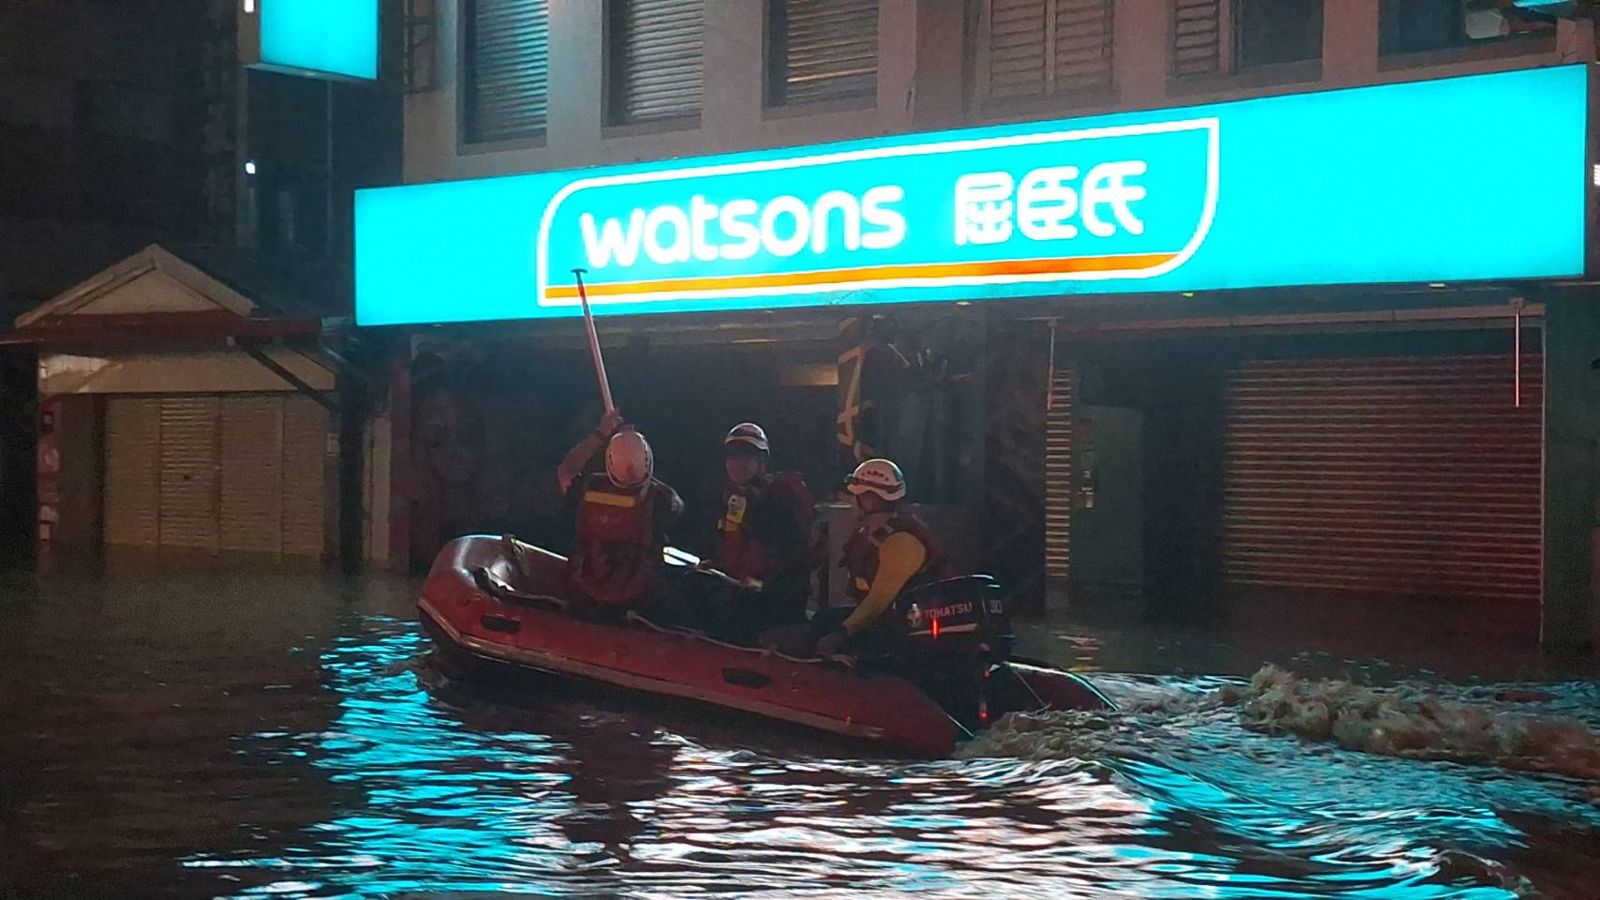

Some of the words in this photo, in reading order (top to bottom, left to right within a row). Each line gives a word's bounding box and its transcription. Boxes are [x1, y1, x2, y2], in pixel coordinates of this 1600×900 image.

[580, 185, 907, 269] watsons
[954, 160, 1147, 246] 屈臣氏
[924, 602, 973, 619] TOHATSU
